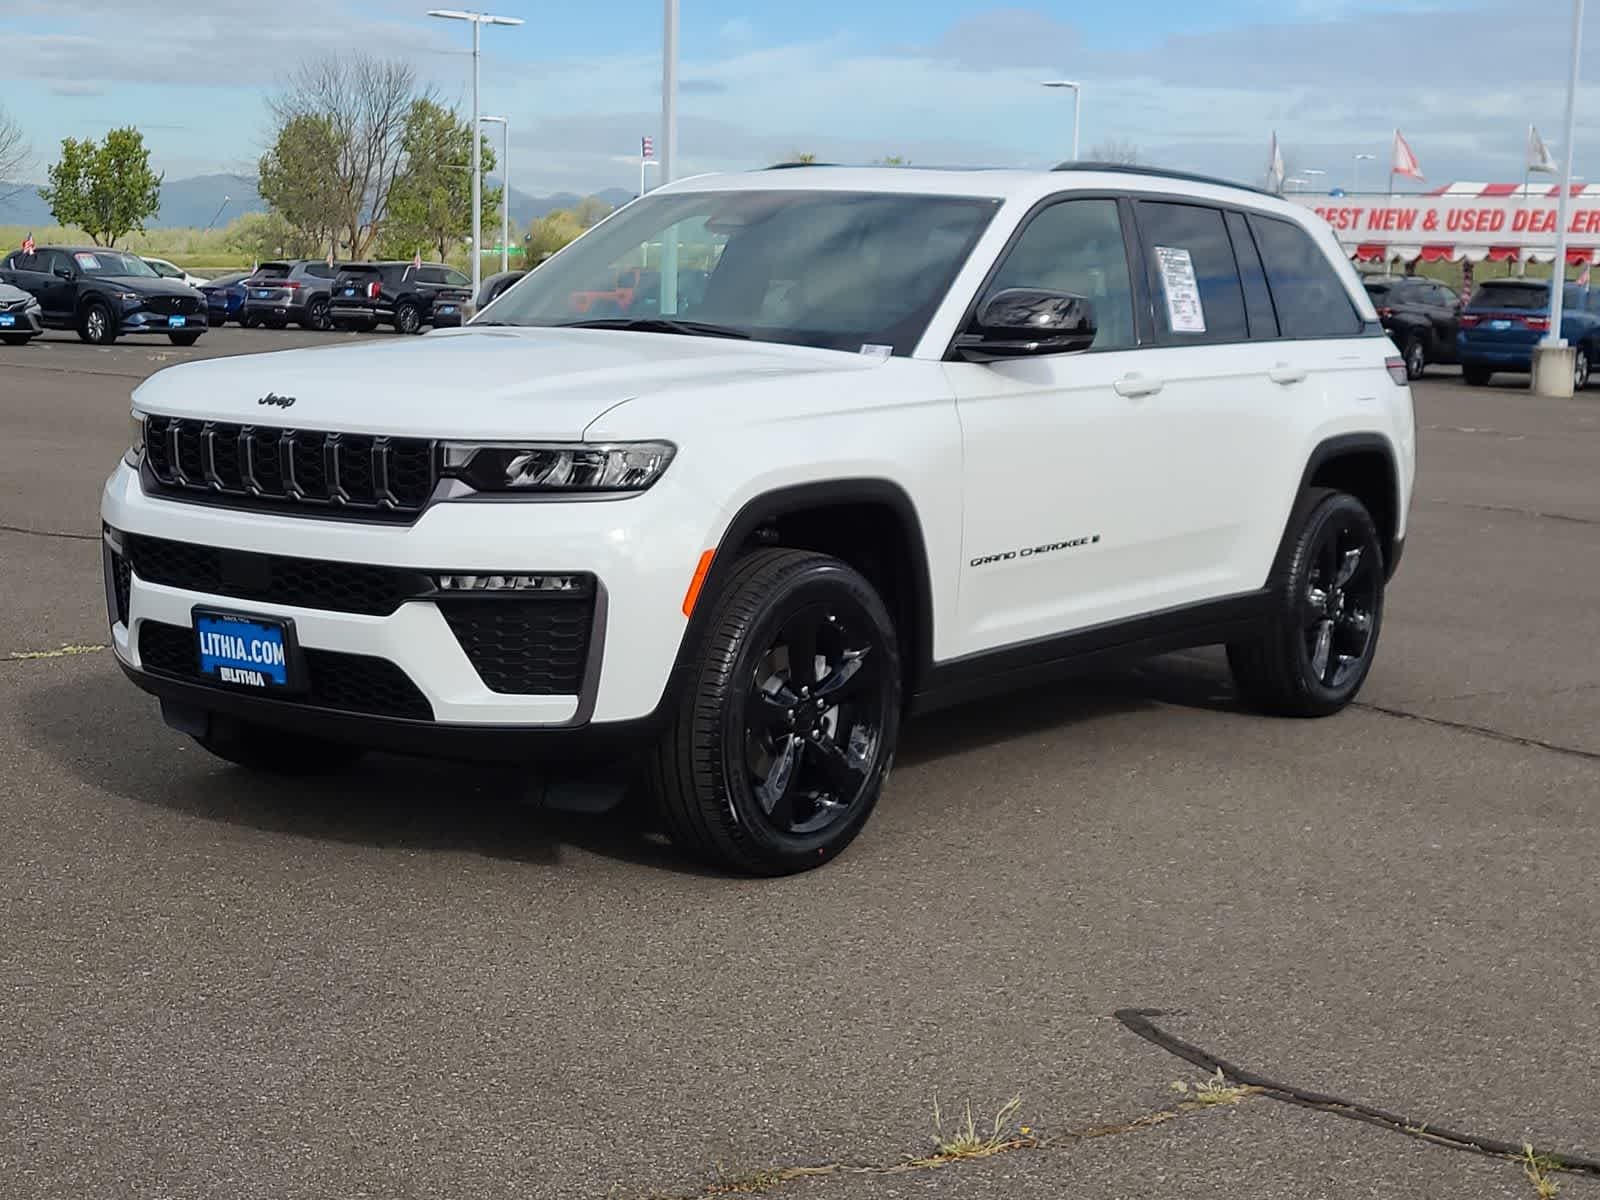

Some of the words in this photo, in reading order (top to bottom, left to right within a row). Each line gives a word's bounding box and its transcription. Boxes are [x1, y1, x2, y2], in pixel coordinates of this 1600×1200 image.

[1367, 208, 1417, 231] NEW
[1422, 208, 1440, 231] &
[1446, 209, 1505, 232] USED
[1511, 210, 1600, 233] DEAER
[258, 392, 296, 409] Jeep
[970, 551, 1016, 567] GRAND
[1020, 537, 1088, 557] CHEROKEE
[200, 631, 286, 666] LITHIA.COM
[231, 668, 265, 687] LITHIA
